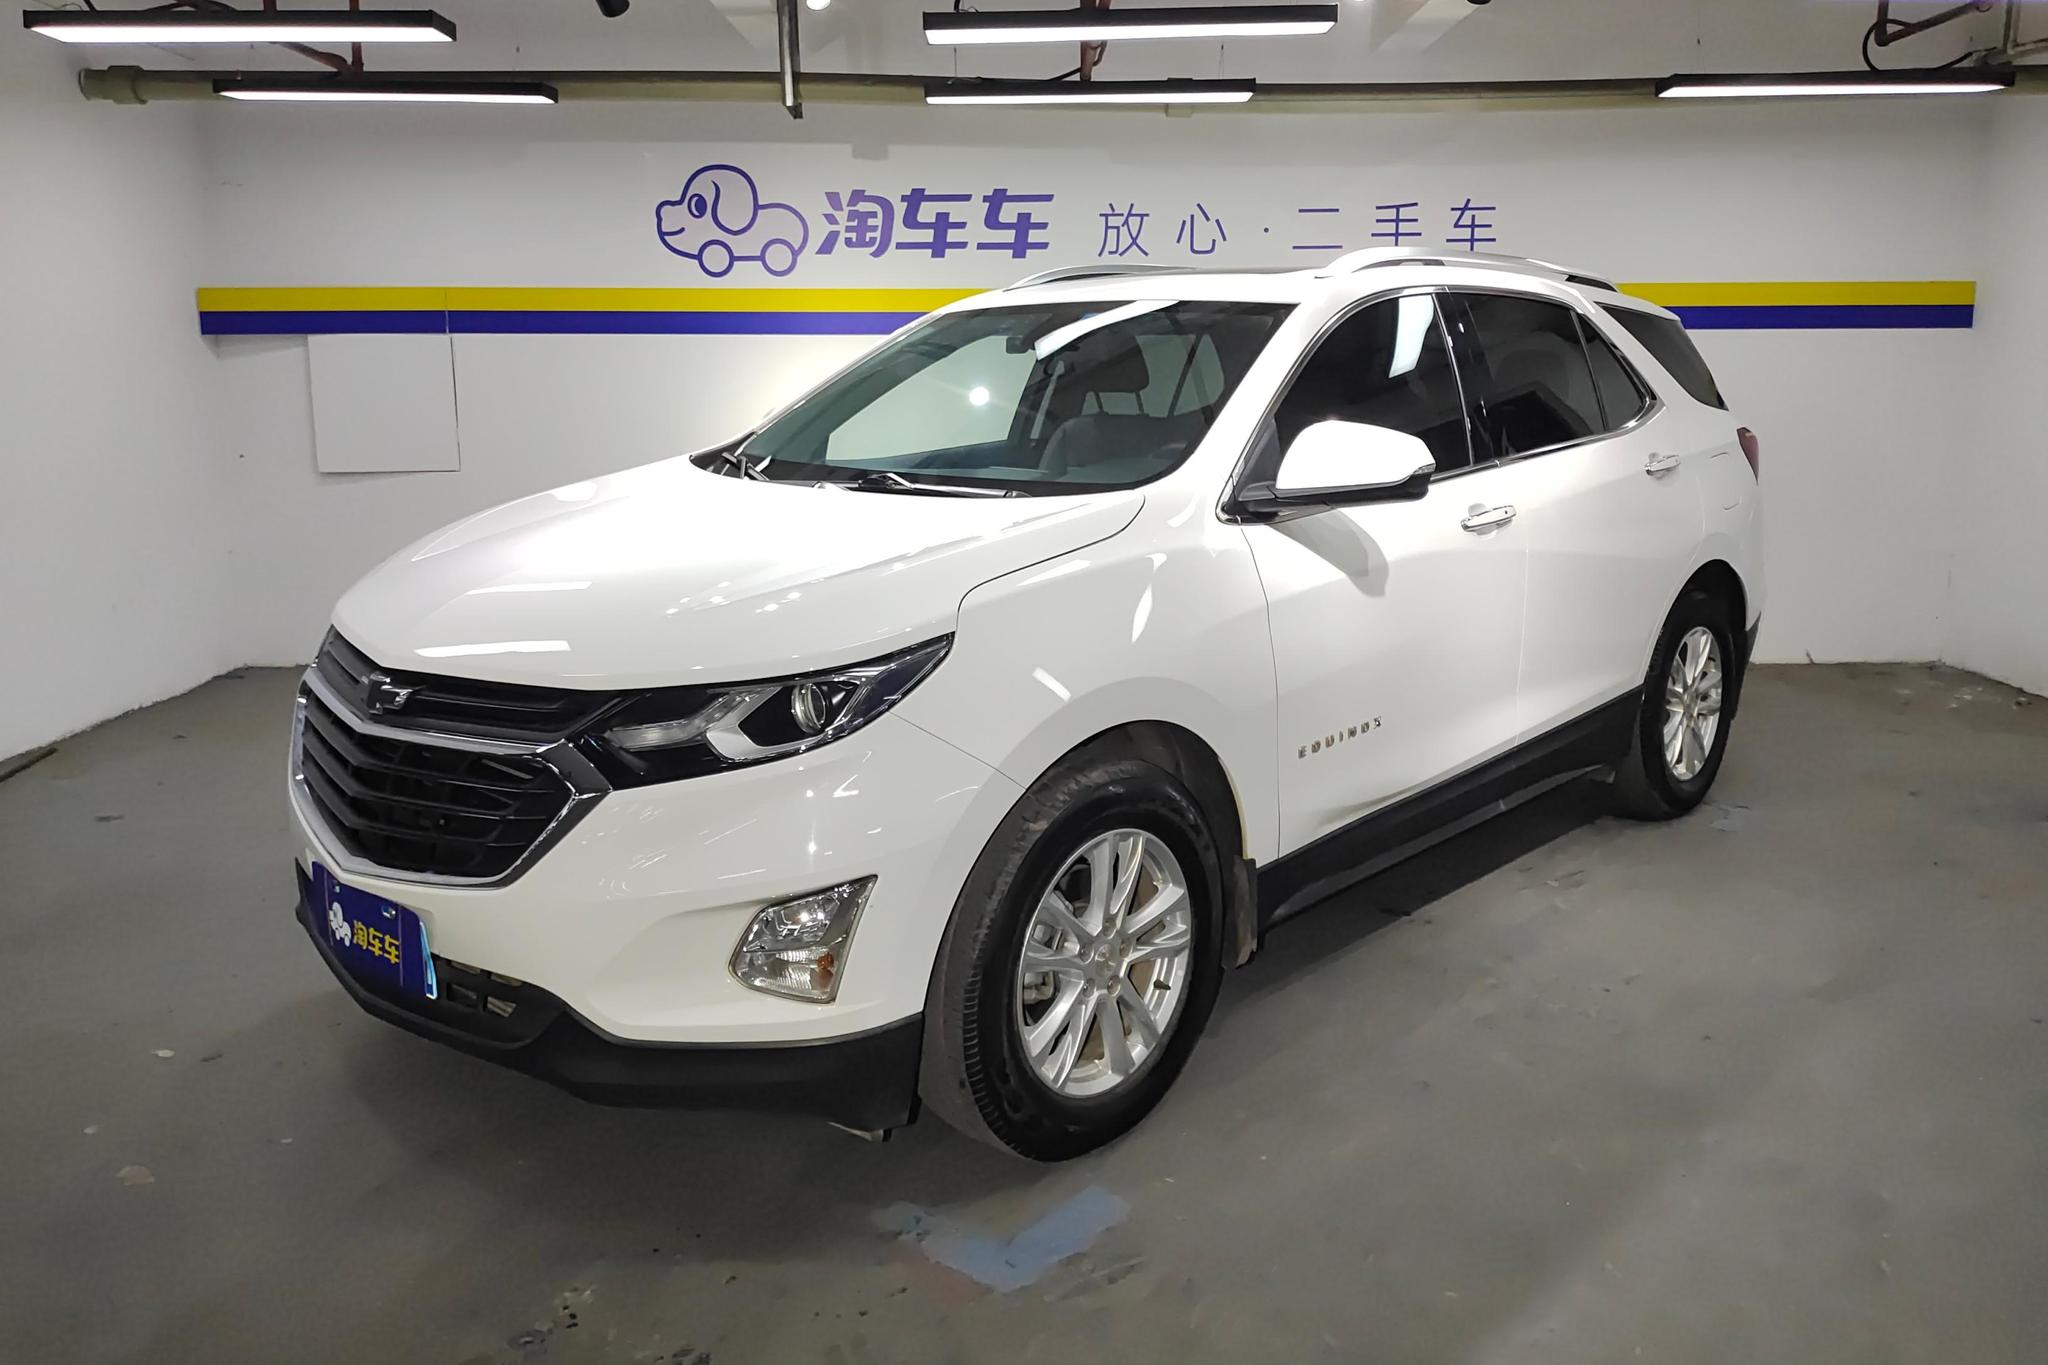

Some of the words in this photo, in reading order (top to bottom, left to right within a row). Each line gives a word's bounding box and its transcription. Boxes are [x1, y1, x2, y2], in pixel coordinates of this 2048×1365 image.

[815, 188, 1055, 258] 淘车车
[353, 919, 400, 964] 淘车车
